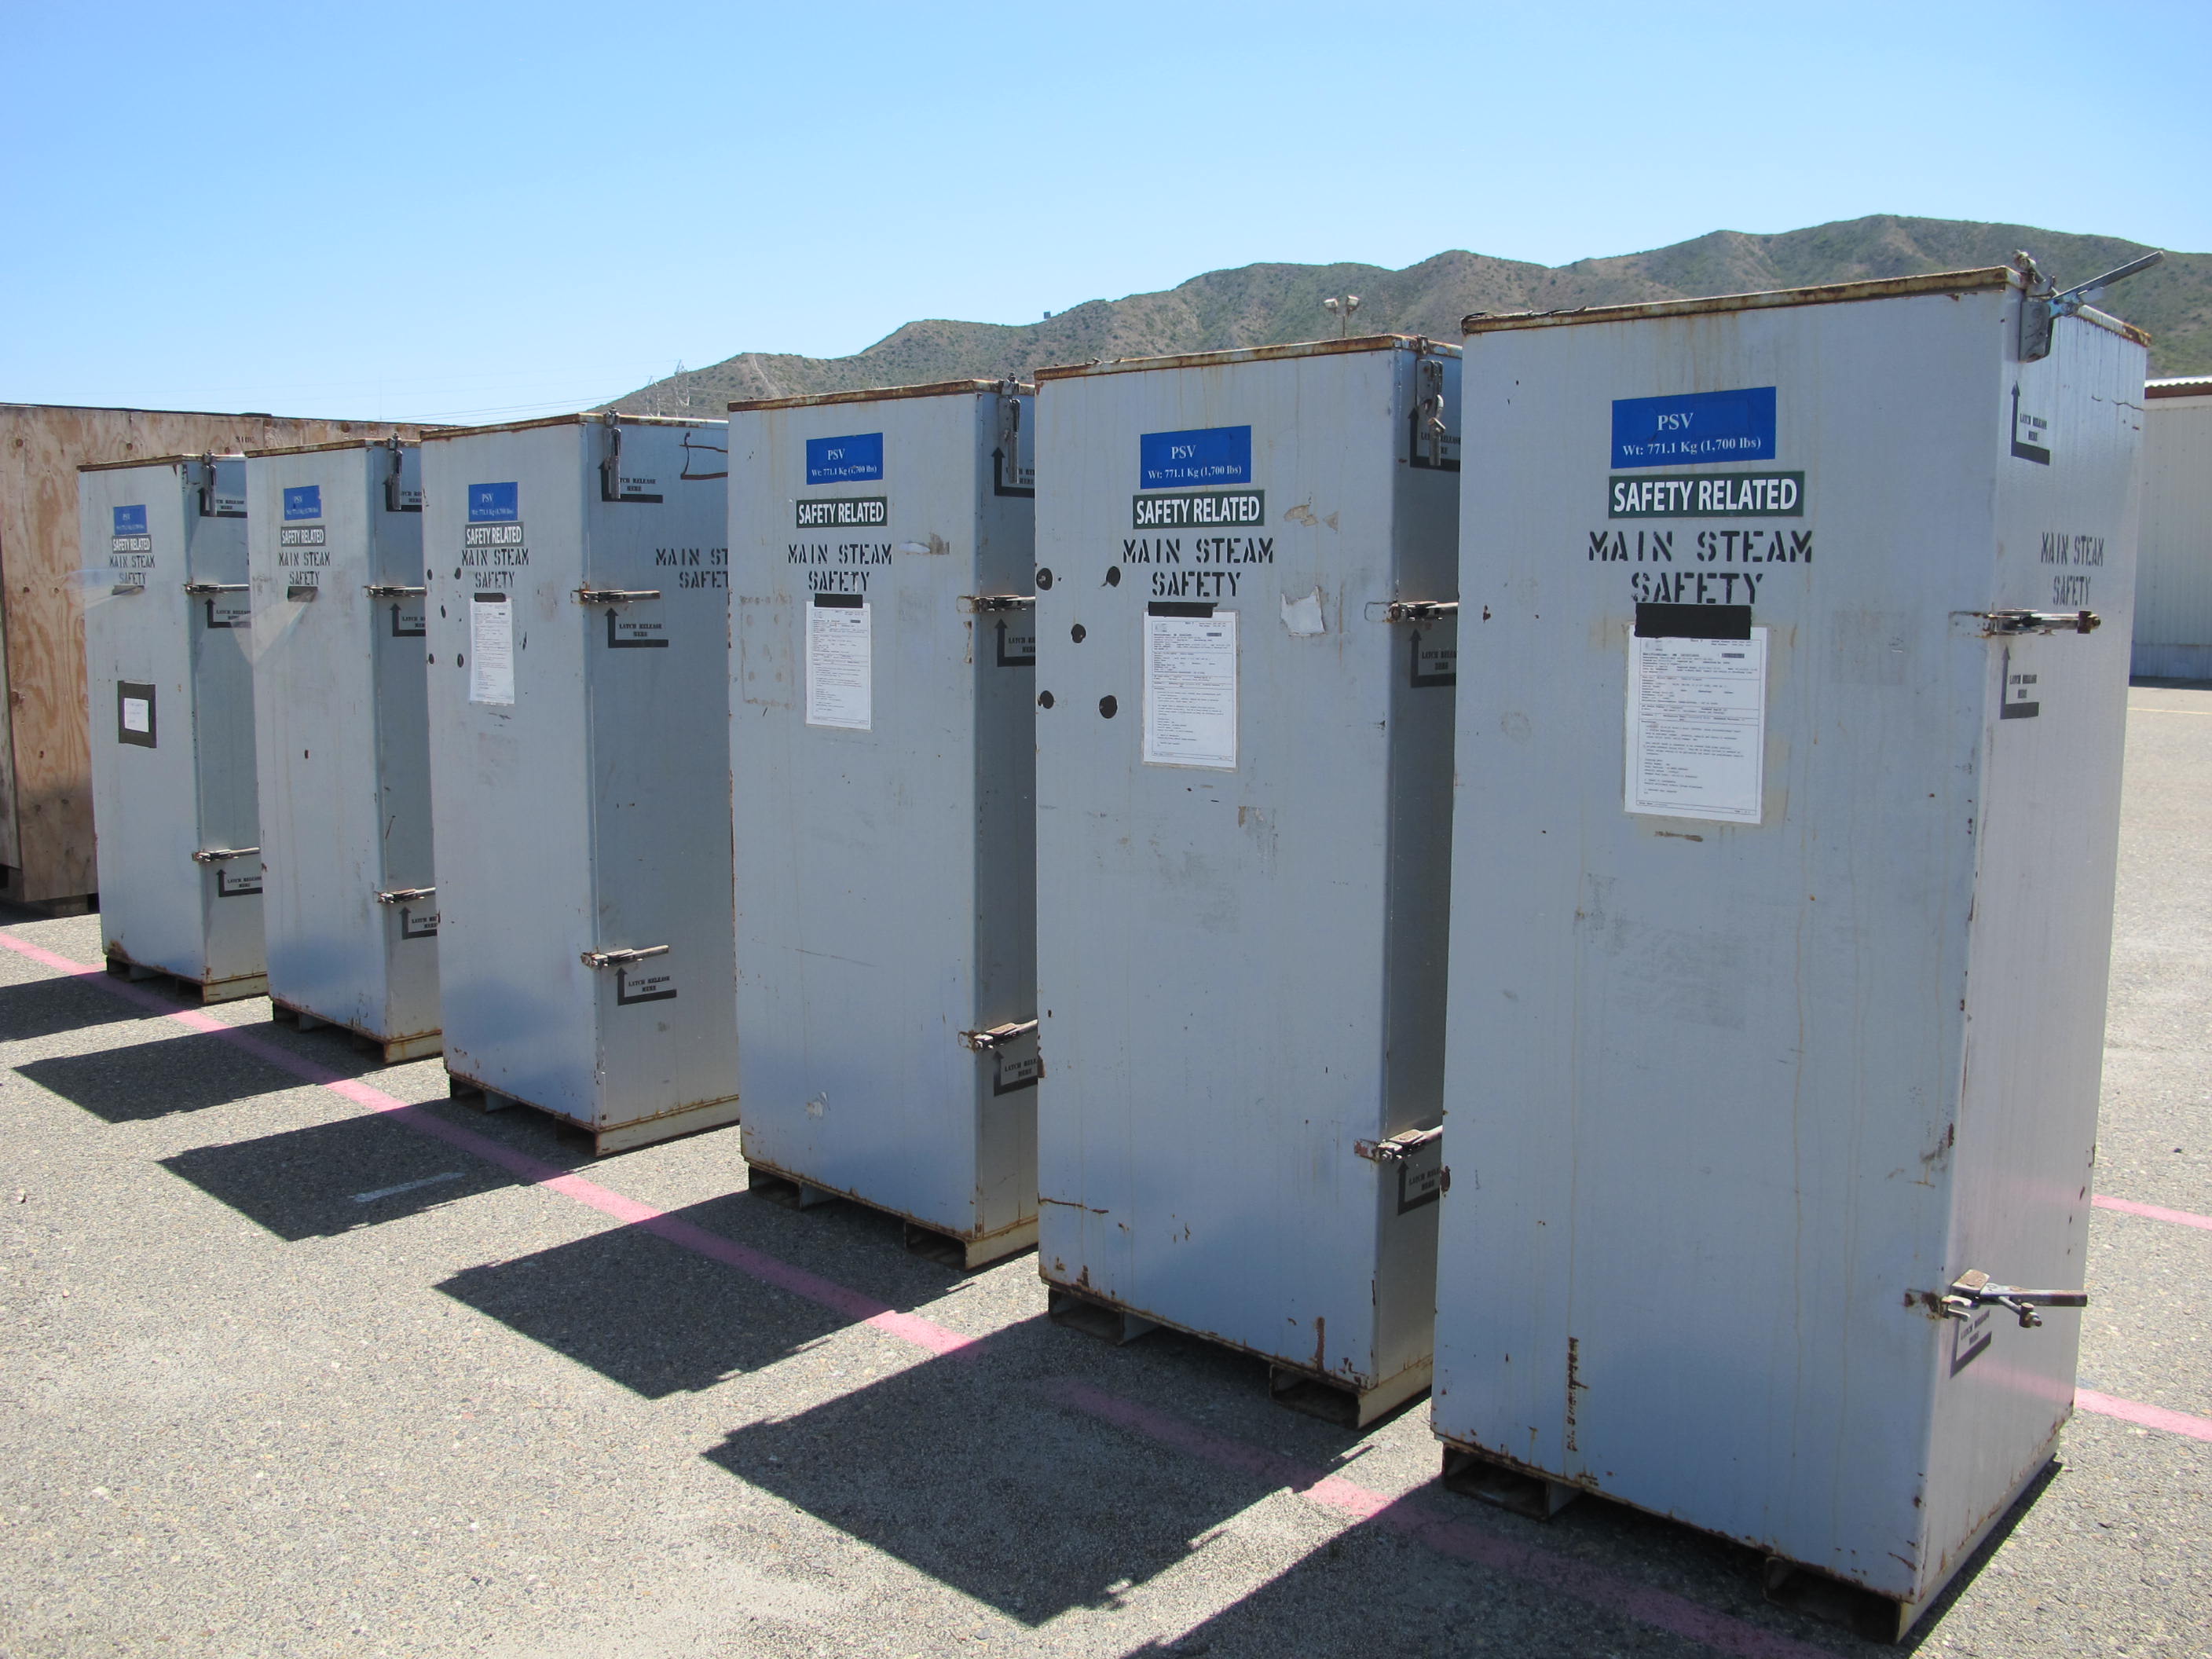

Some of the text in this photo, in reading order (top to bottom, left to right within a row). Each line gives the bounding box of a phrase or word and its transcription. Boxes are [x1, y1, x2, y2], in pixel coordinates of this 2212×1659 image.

[1657, 413, 1694, 430] PSV
[827, 448, 845, 460] PSV
[1171, 445, 1197, 459] PSV
[1623, 437, 1761, 456] Wt: 771.1 Kg (1,700 lbs)
[1148, 471, 1163, 479] Wt:
[1165, 468, 1185, 478] 771.1
[1187, 467, 1199, 478] Kg
[1227, 465, 1242, 474] lbs)
[482, 493, 493, 503] PSV
[1613, 478, 1797, 512] SAFETY RELATED
[798, 501, 884, 525] SAFETY RELATED
[1137, 496, 1260, 525] SAFETY RELATED
[113, 537, 151, 551] SAFETY RELATED
[282, 529, 324, 544] SAFETY RELATED
[467, 526, 522, 545] SAFETY RELATED
[788, 544, 892, 565] MAIN STEAM
[1123, 537, 1273, 564] MAIN STEAM
[1588, 530, 1813, 562] MAIN STEAM
[2041, 532, 2104, 567] MAIN STEAM
[279, 551, 331, 566] MAIN STEAM
[462, 548, 529, 566] MAIN STEAM
[656, 548, 700, 566] MAIN
[119, 572, 146, 584] SAFETY
[289, 571, 320, 585] SAFETY
[474, 571, 515, 589] SAFETY
[808, 570, 870, 592] SAFETY
[1152, 571, 1241, 597] SAFETY
[1631, 572, 1763, 604] SAFETY
[2053, 575, 2091, 606] SAFETY
